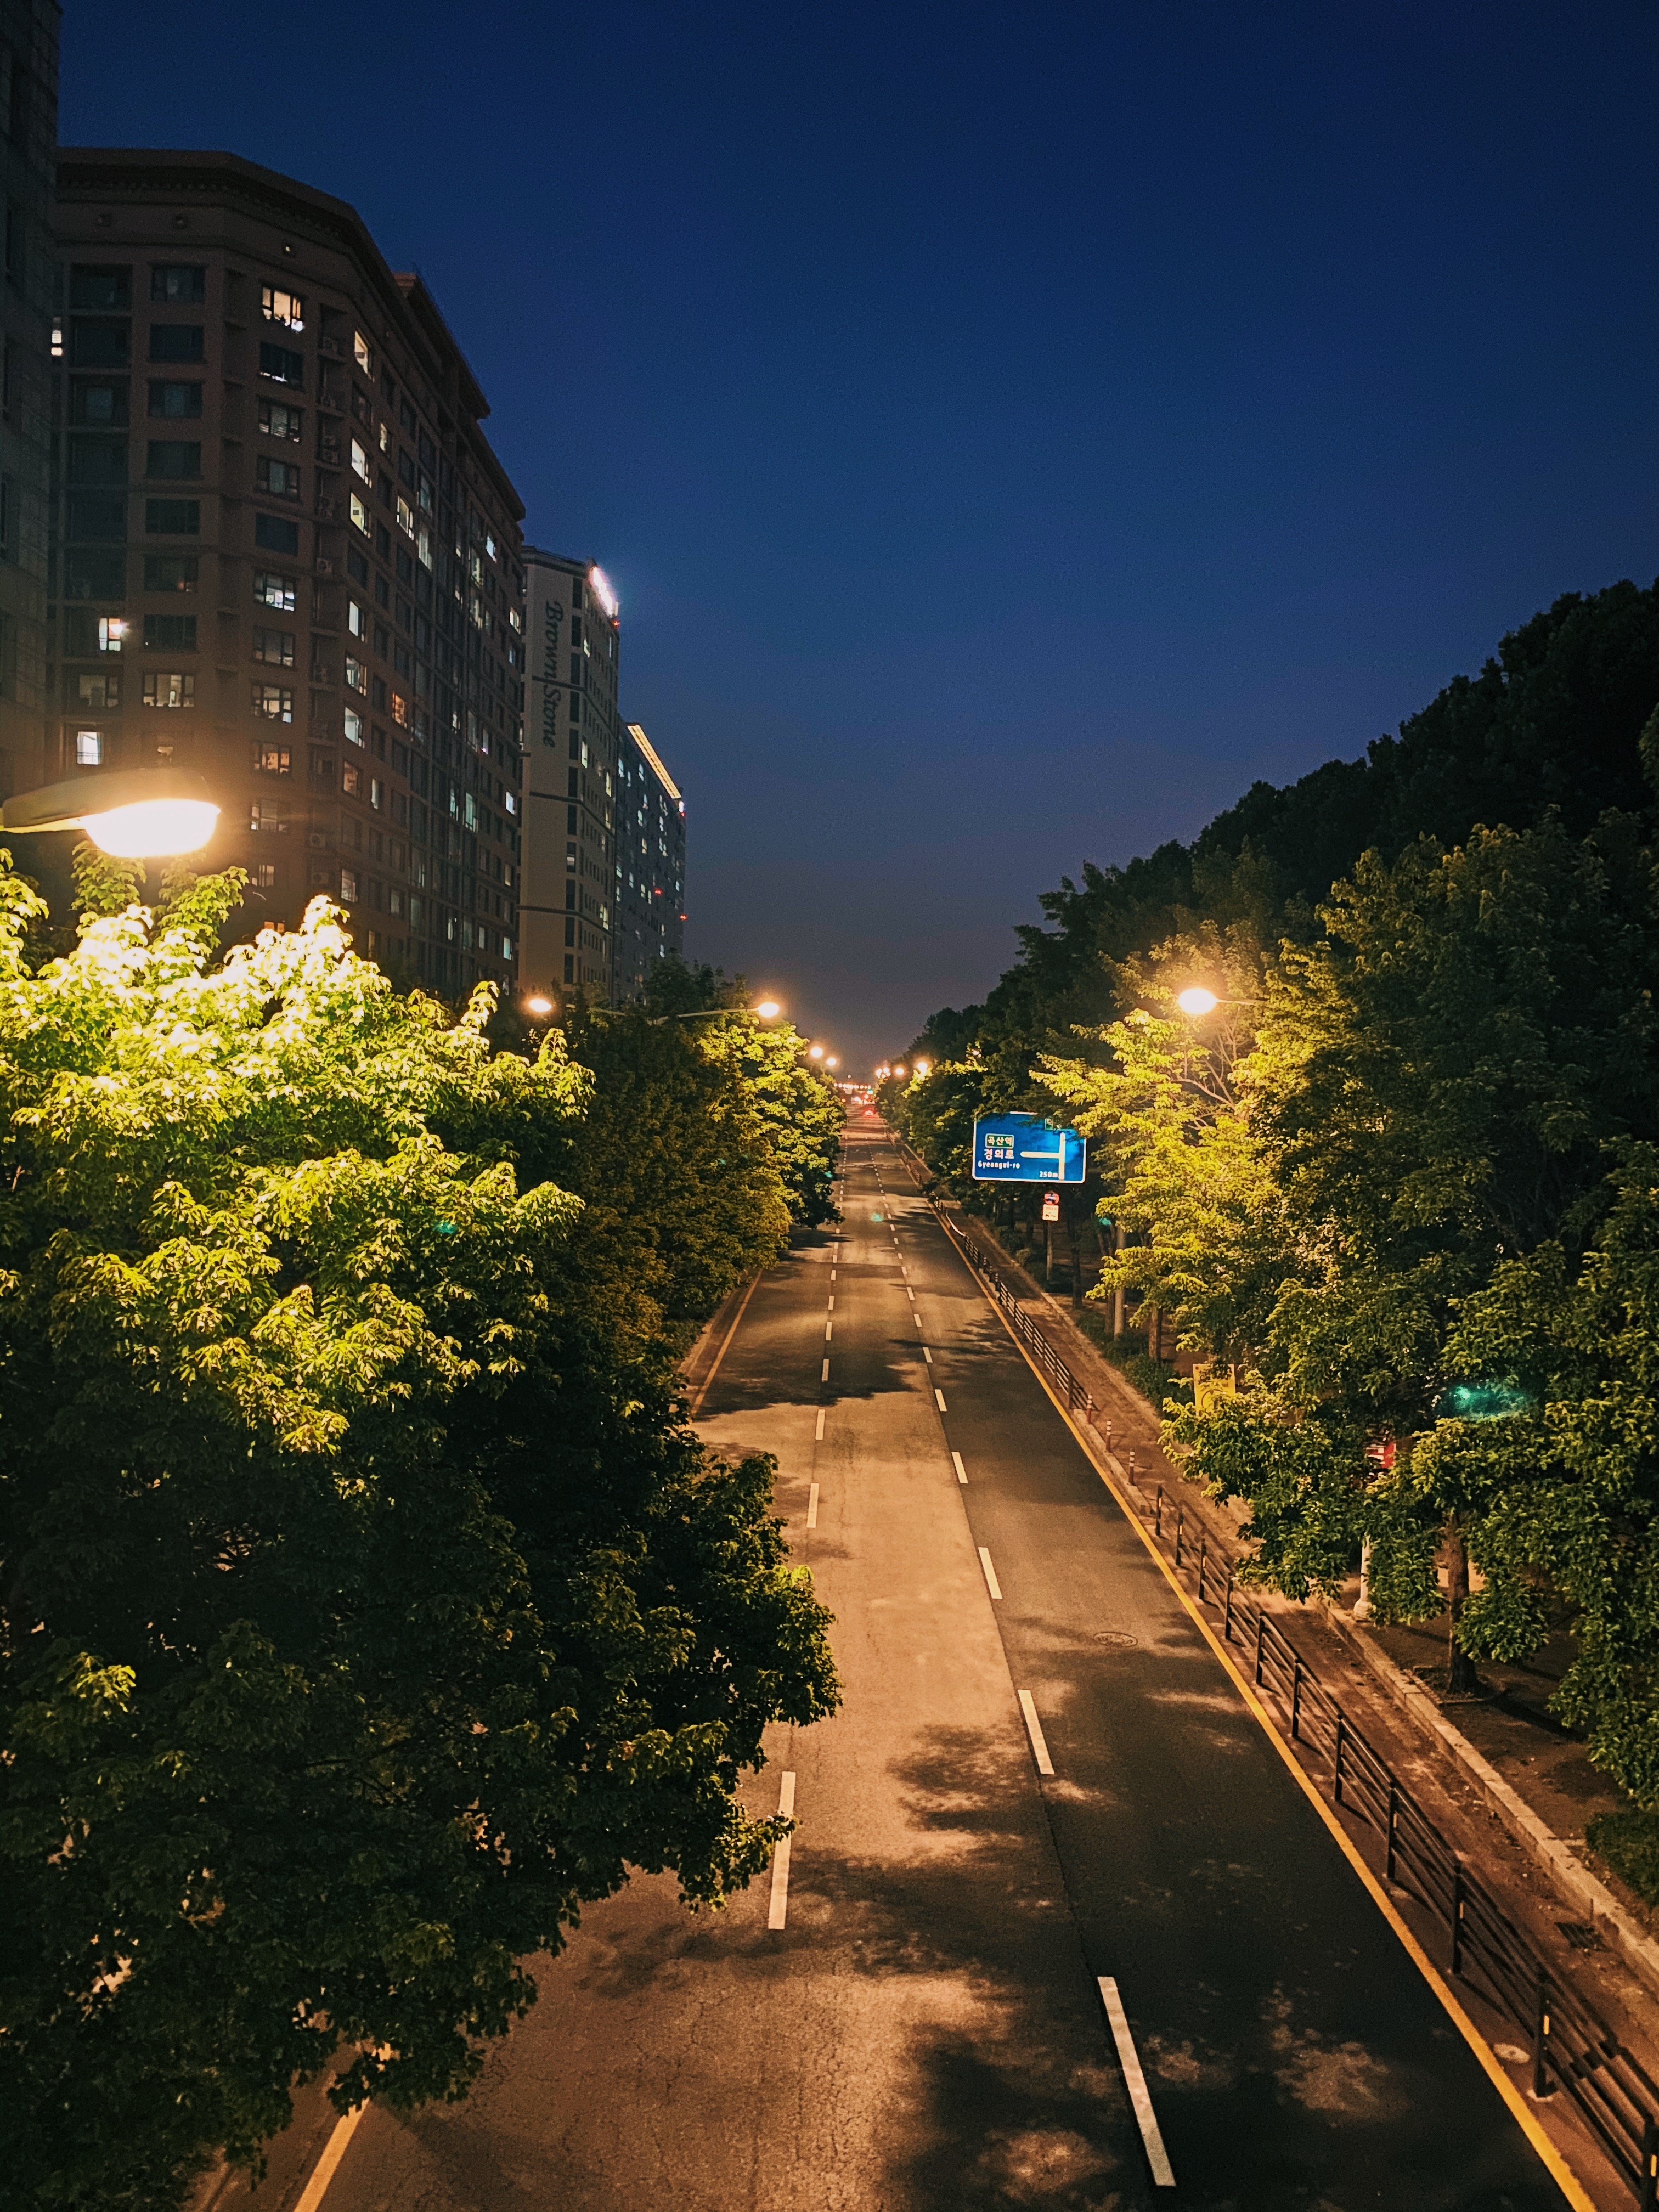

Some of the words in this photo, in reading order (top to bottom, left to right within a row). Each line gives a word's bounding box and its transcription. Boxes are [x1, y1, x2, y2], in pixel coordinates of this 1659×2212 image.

[545, 600, 563, 678] Brown
[543, 684, 561, 747] Stone
[987, 1136, 1012, 1146] 곡산역
[984, 1149, 1014, 1160] 경의로
[978, 1160, 1020, 1169] Gyeongui-ro
